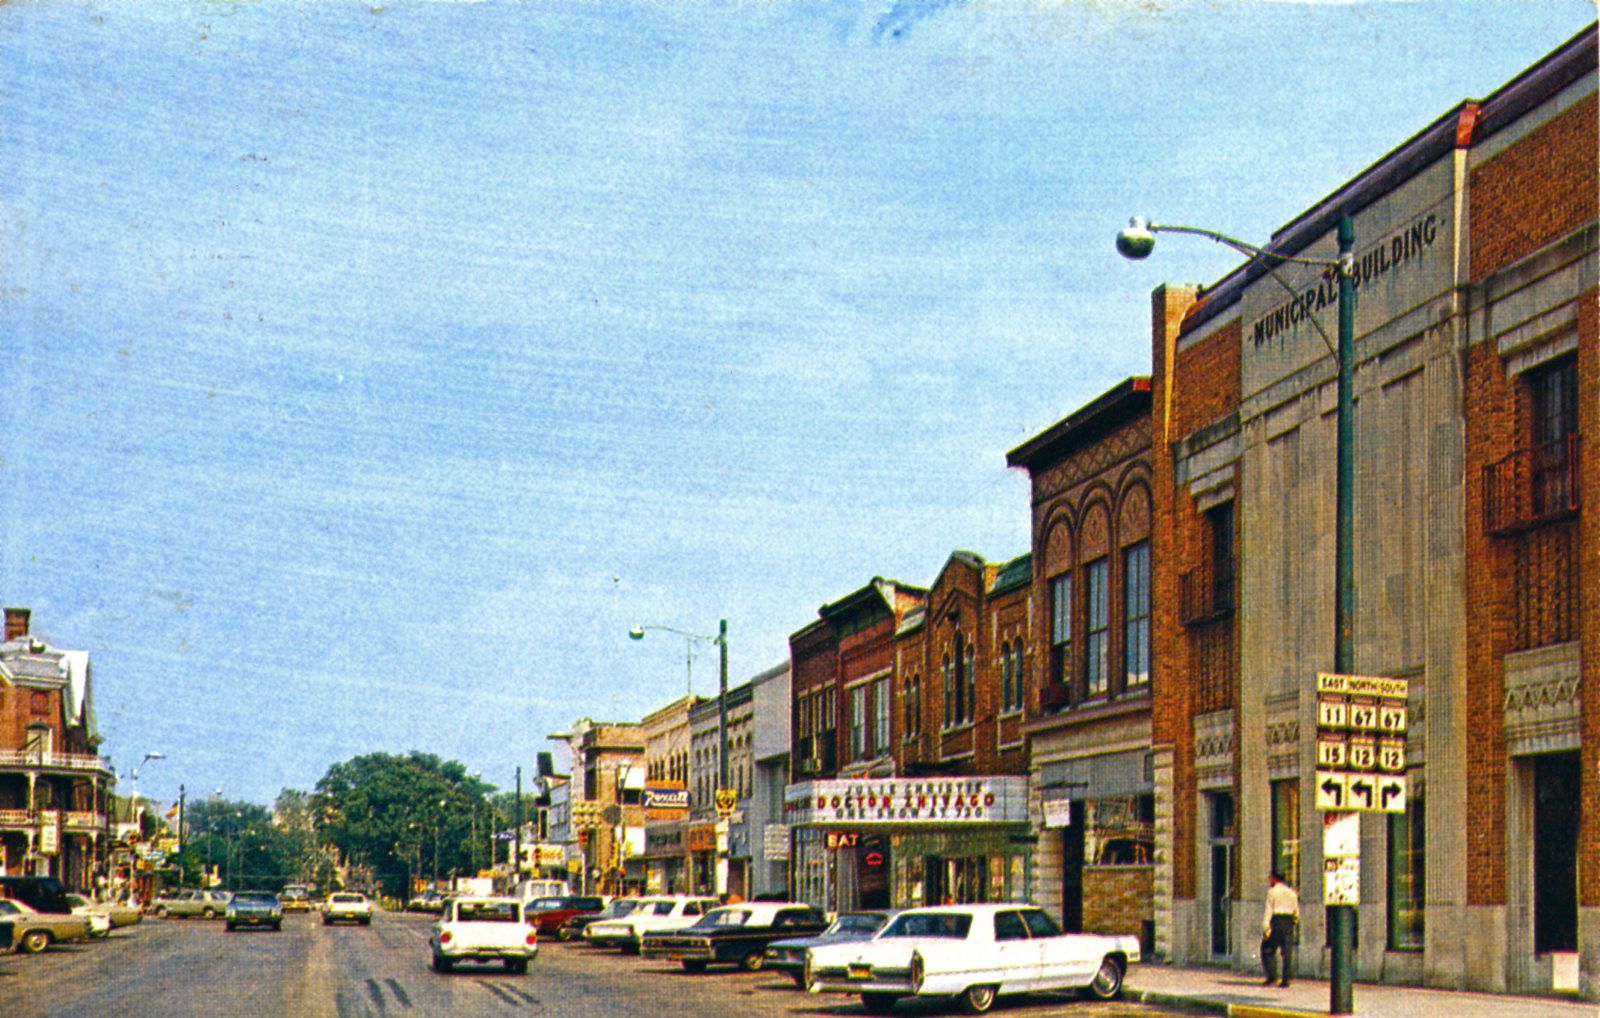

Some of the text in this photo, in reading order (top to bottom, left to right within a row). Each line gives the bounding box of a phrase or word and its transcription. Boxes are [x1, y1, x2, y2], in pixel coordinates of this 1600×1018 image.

[1253, 213, 1437, 347] MUNICIPAL BUILDING
[1322, 676, 1405, 693] EAST NORTH SOUTH
[1326, 707, 1401, 727] 11 67 67
[1325, 746, 1400, 768] 15 12 12
[845, 781, 984, 795] JULIE CHRISTIE
[817, 794, 892, 810] DOCTOR
[904, 791, 996, 809] ZHIVAGO
[835, 807, 865, 819] ONE
[877, 807, 919, 819] SHOW
[928, 806, 946, 819] AT
[827, 831, 860, 848] EAT
